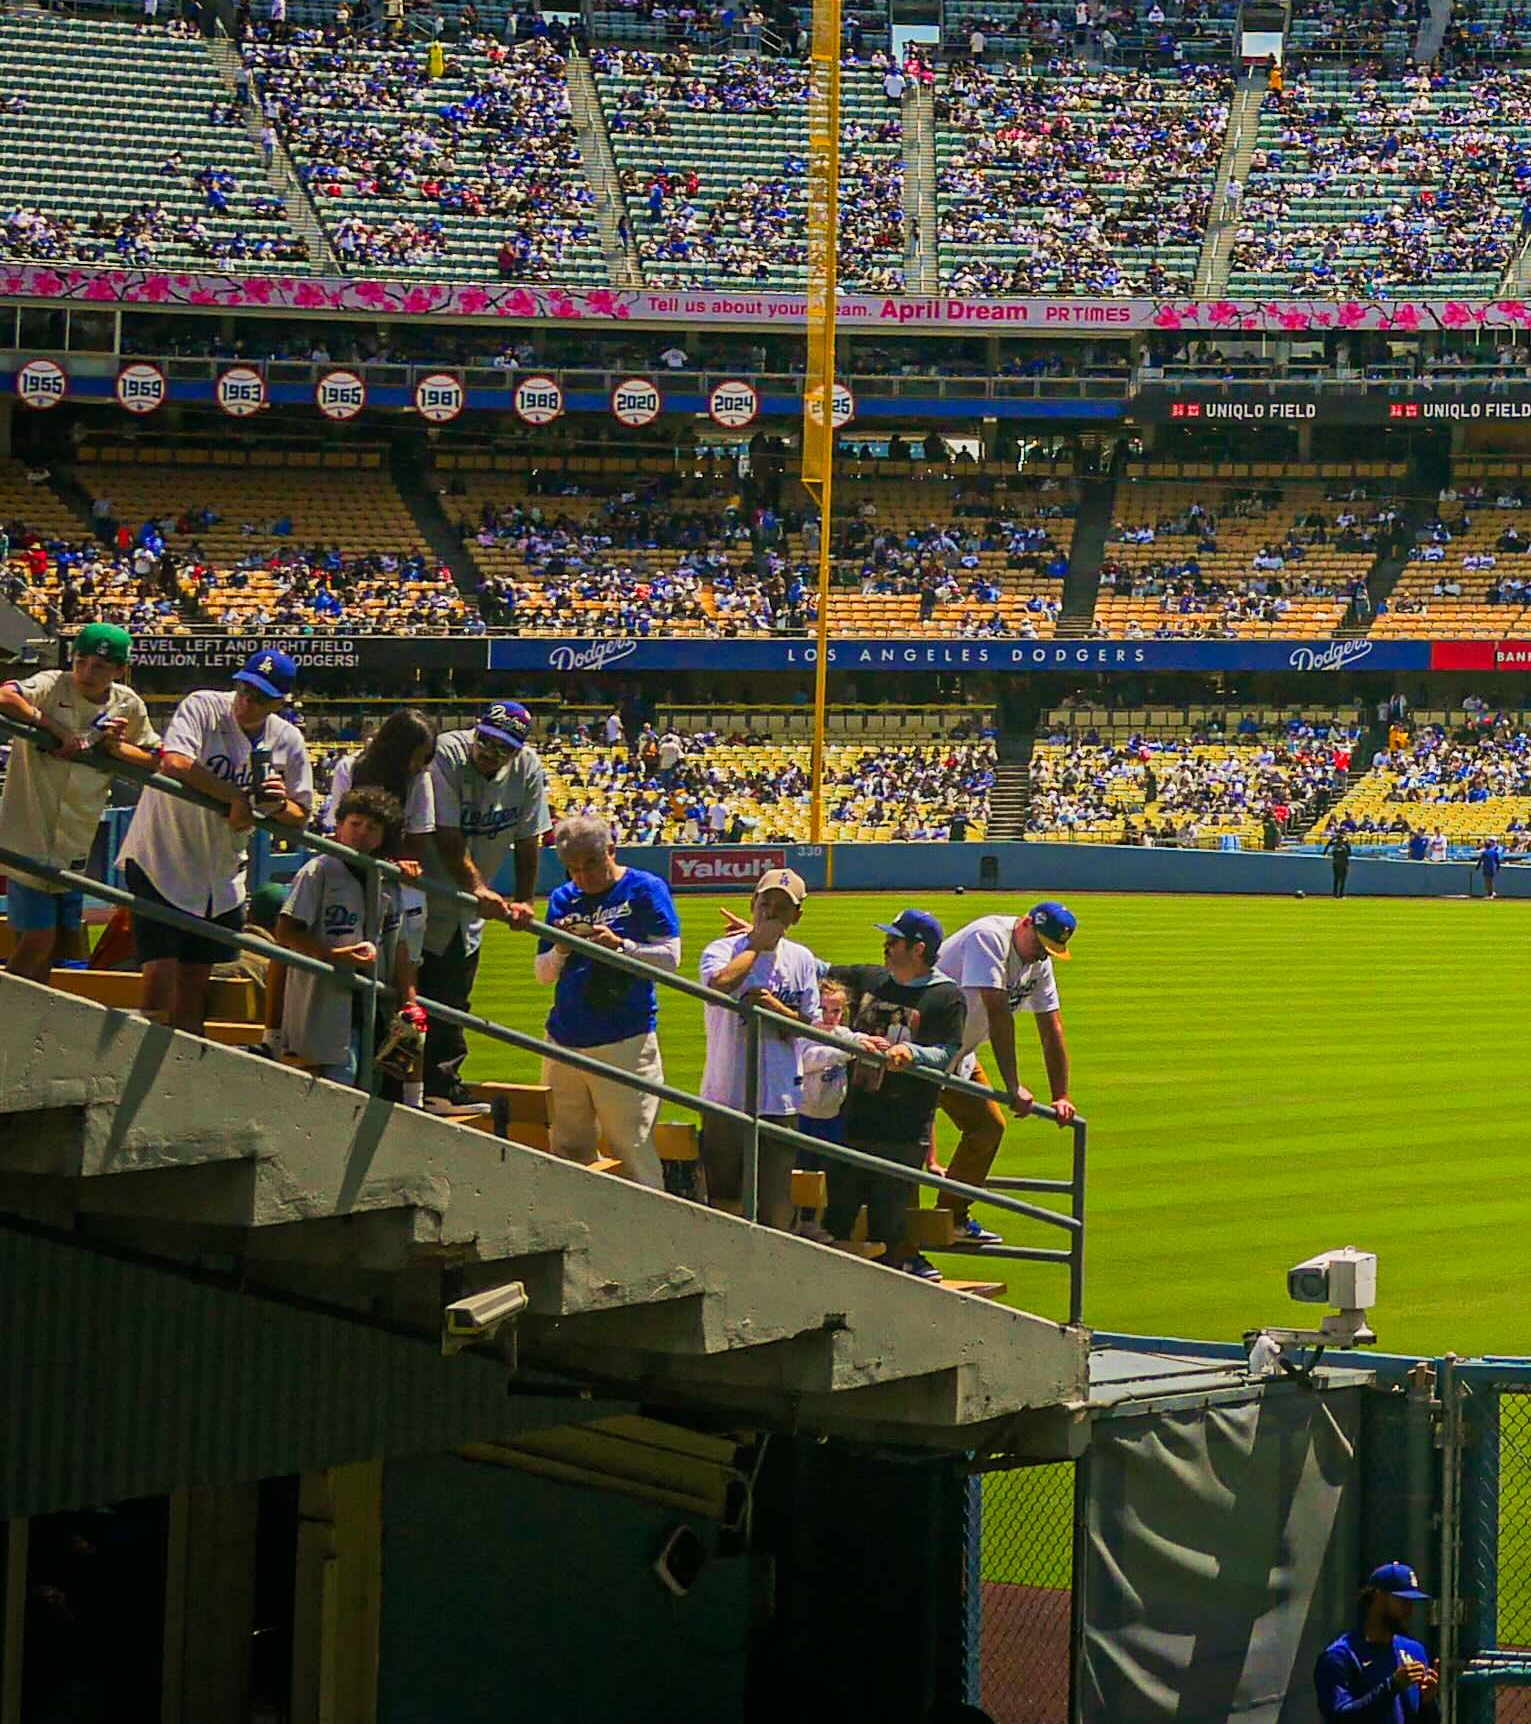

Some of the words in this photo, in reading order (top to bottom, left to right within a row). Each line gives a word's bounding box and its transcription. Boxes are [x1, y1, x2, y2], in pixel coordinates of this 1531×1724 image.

[648, 297, 678, 312] Tell
[685, 301, 705, 313] us
[711, 299, 762, 314] about
[768, 303, 808, 318] your
[880, 298, 940, 322] April
[946, 301, 1028, 321] Dream
[23, 374, 61, 394] 1955
[123, 377, 161, 399] 1959
[222, 382, 261, 402] 1963
[321, 385, 361, 405] 1965
[420, 388, 460, 409] 1981
[617, 393, 657, 411] 2020
[714, 394, 754, 414] 2024
[1206, 404, 1264, 420] UNIQLO
[1269, 404, 1316, 418] FIELD
[1423, 404, 1481, 419] UNIQLO
[1486, 404, 1531, 417] FIELD
[131, 639, 181, 653] LEVEL,
[186, 639, 223, 652] LEFT
[225, 639, 258, 652] AND
[262, 640, 308, 652] RIGHT
[311, 640, 354, 652] FIELD
[549, 639, 637, 670] Dodgers
[788, 649, 836, 662] LOS
[860, 648, 989, 662] ANGELES
[1012, 648, 1144, 662] DODGERS
[1290, 640, 1373, 670] Dodgers
[129, 653, 200, 667] PAVILION,
[204, 654, 246, 667] LET'S
[292, 655, 360, 667] ODGERS!
[796, 846, 822, 857] 330
[676, 858, 776, 878] Yakult
